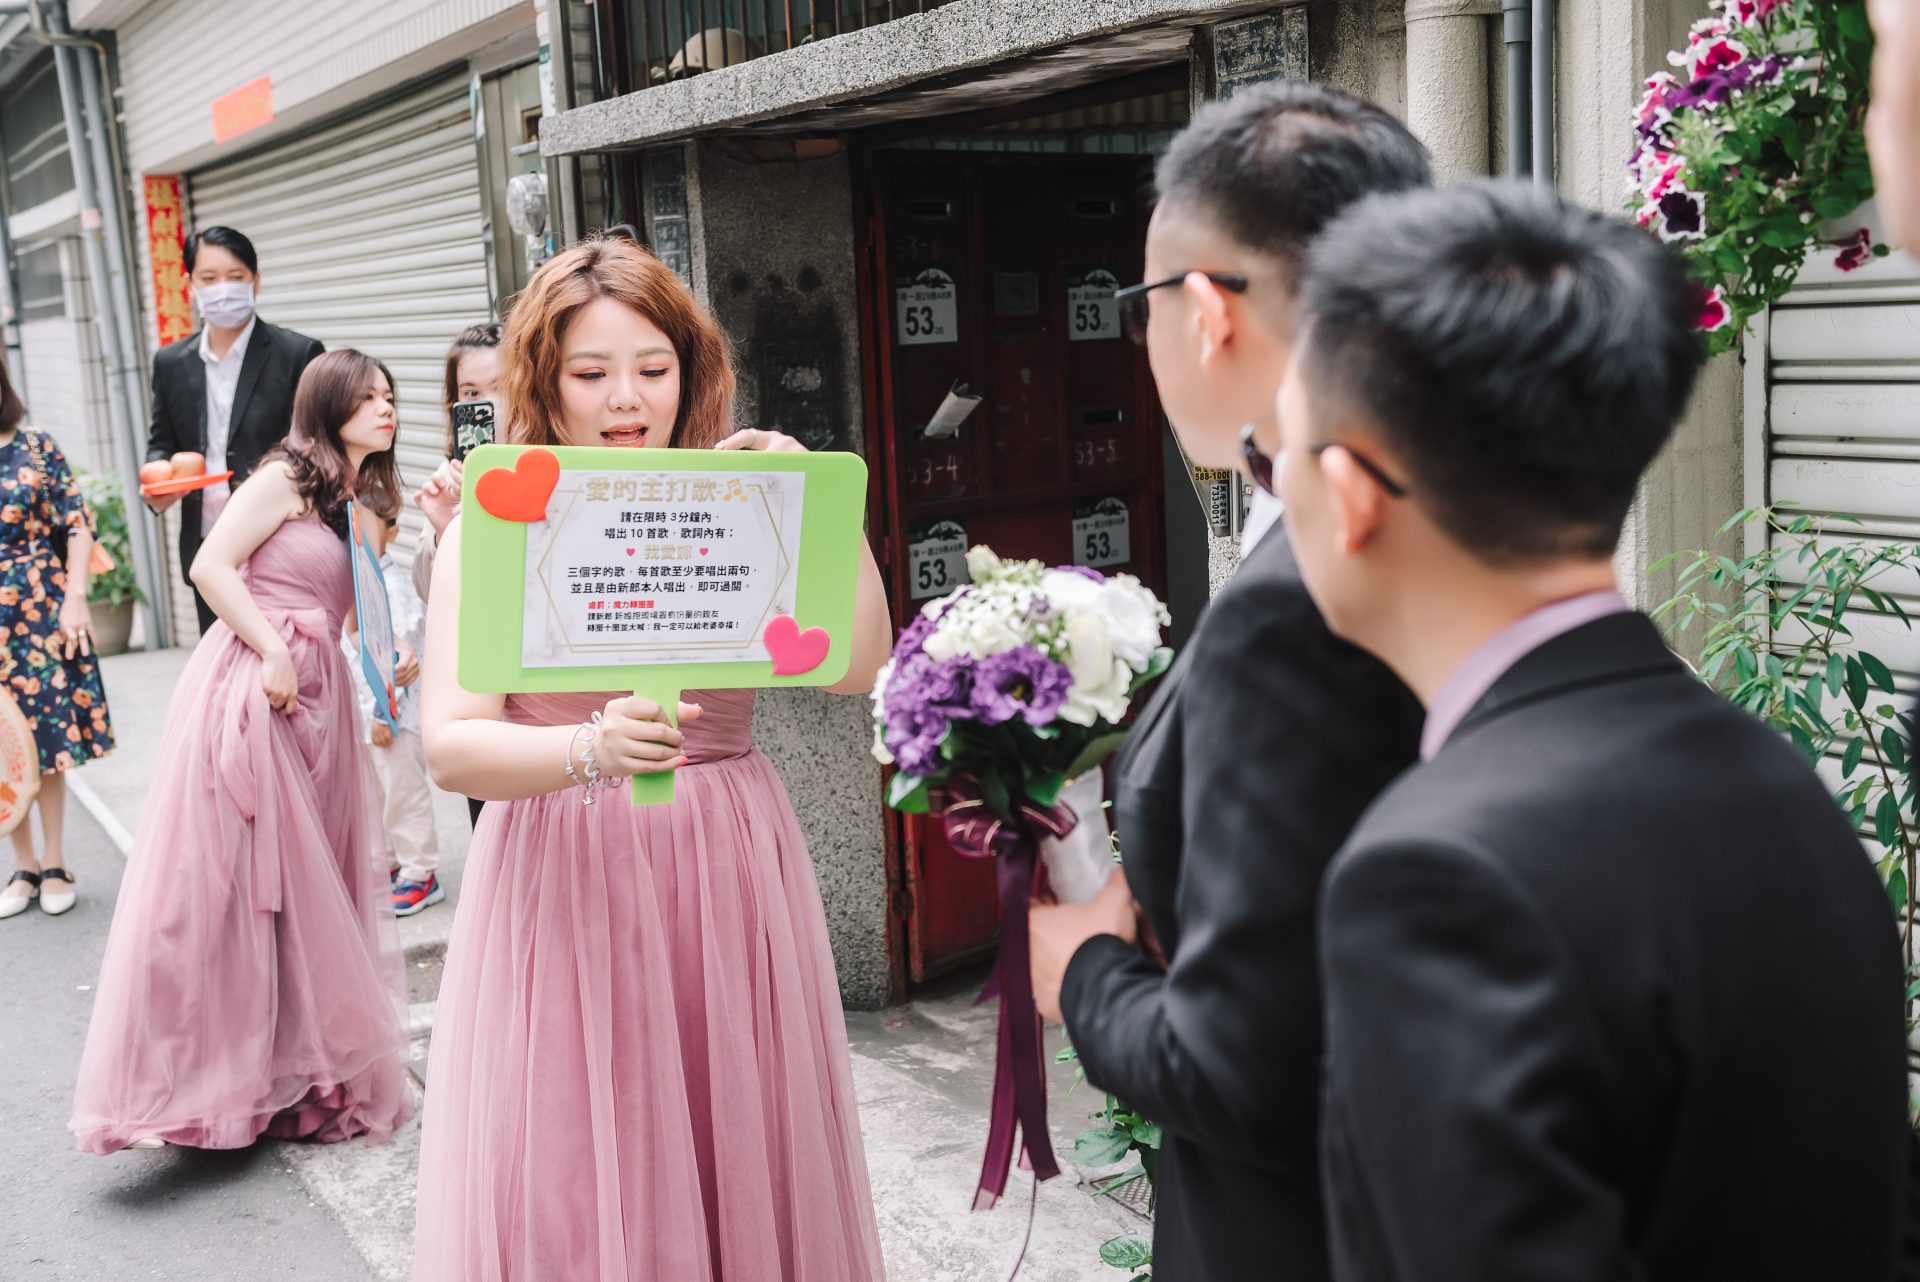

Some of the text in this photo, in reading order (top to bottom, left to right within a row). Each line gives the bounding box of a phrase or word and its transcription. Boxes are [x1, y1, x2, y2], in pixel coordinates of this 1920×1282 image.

[905, 306, 934, 336] 53
[1076, 303, 1101, 332] 53
[1075, 439, 1116, 465] 53-5
[586, 477, 717, 502] 愛的主打歌
[1212, 485, 1220, 525] 733-0011
[1086, 532, 1110, 561] 53
[918, 558, 947, 590] 53
